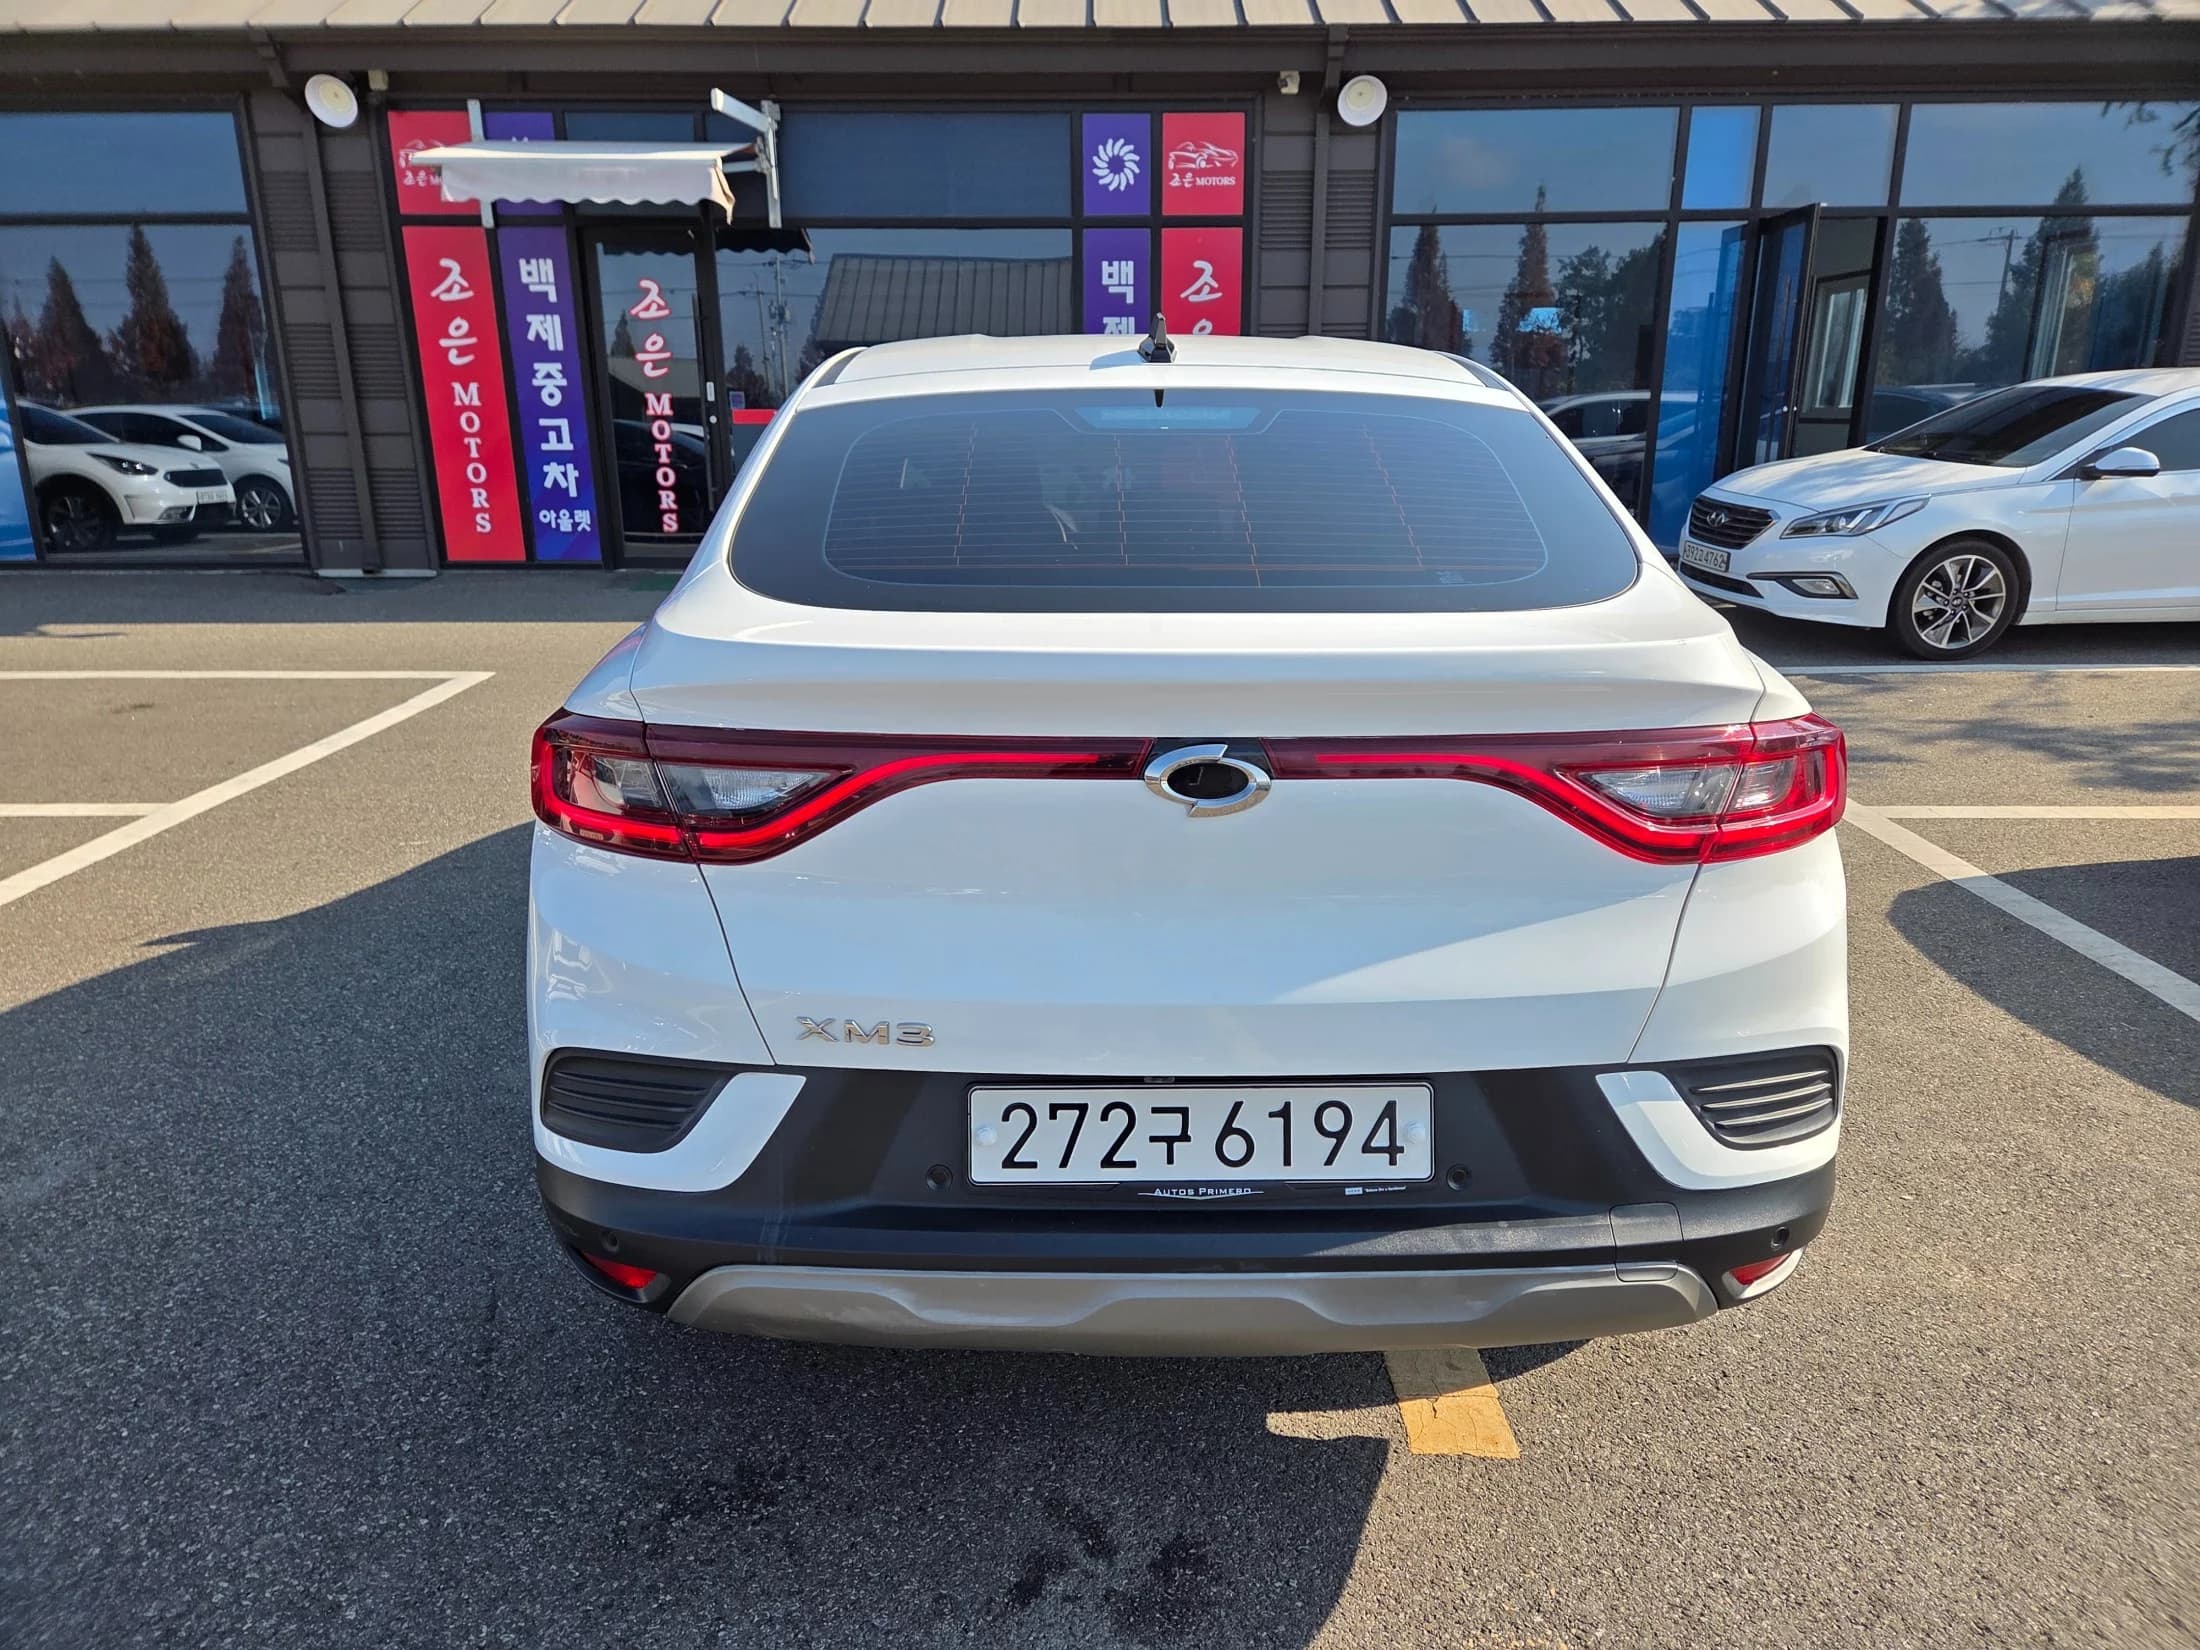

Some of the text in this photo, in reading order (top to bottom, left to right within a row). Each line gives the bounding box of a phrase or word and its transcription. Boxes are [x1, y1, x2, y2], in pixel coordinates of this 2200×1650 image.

[1169, 173, 1236, 188] 조은 MOTORS
[431, 258, 492, 533] 조은 MOTORS
[518, 258, 580, 498] 백제중고차
[630, 279, 679, 533] 조은 MOTORS
[796, 1016, 936, 1047] XM3
[1154, 1187, 1195, 1197] AUTOS
